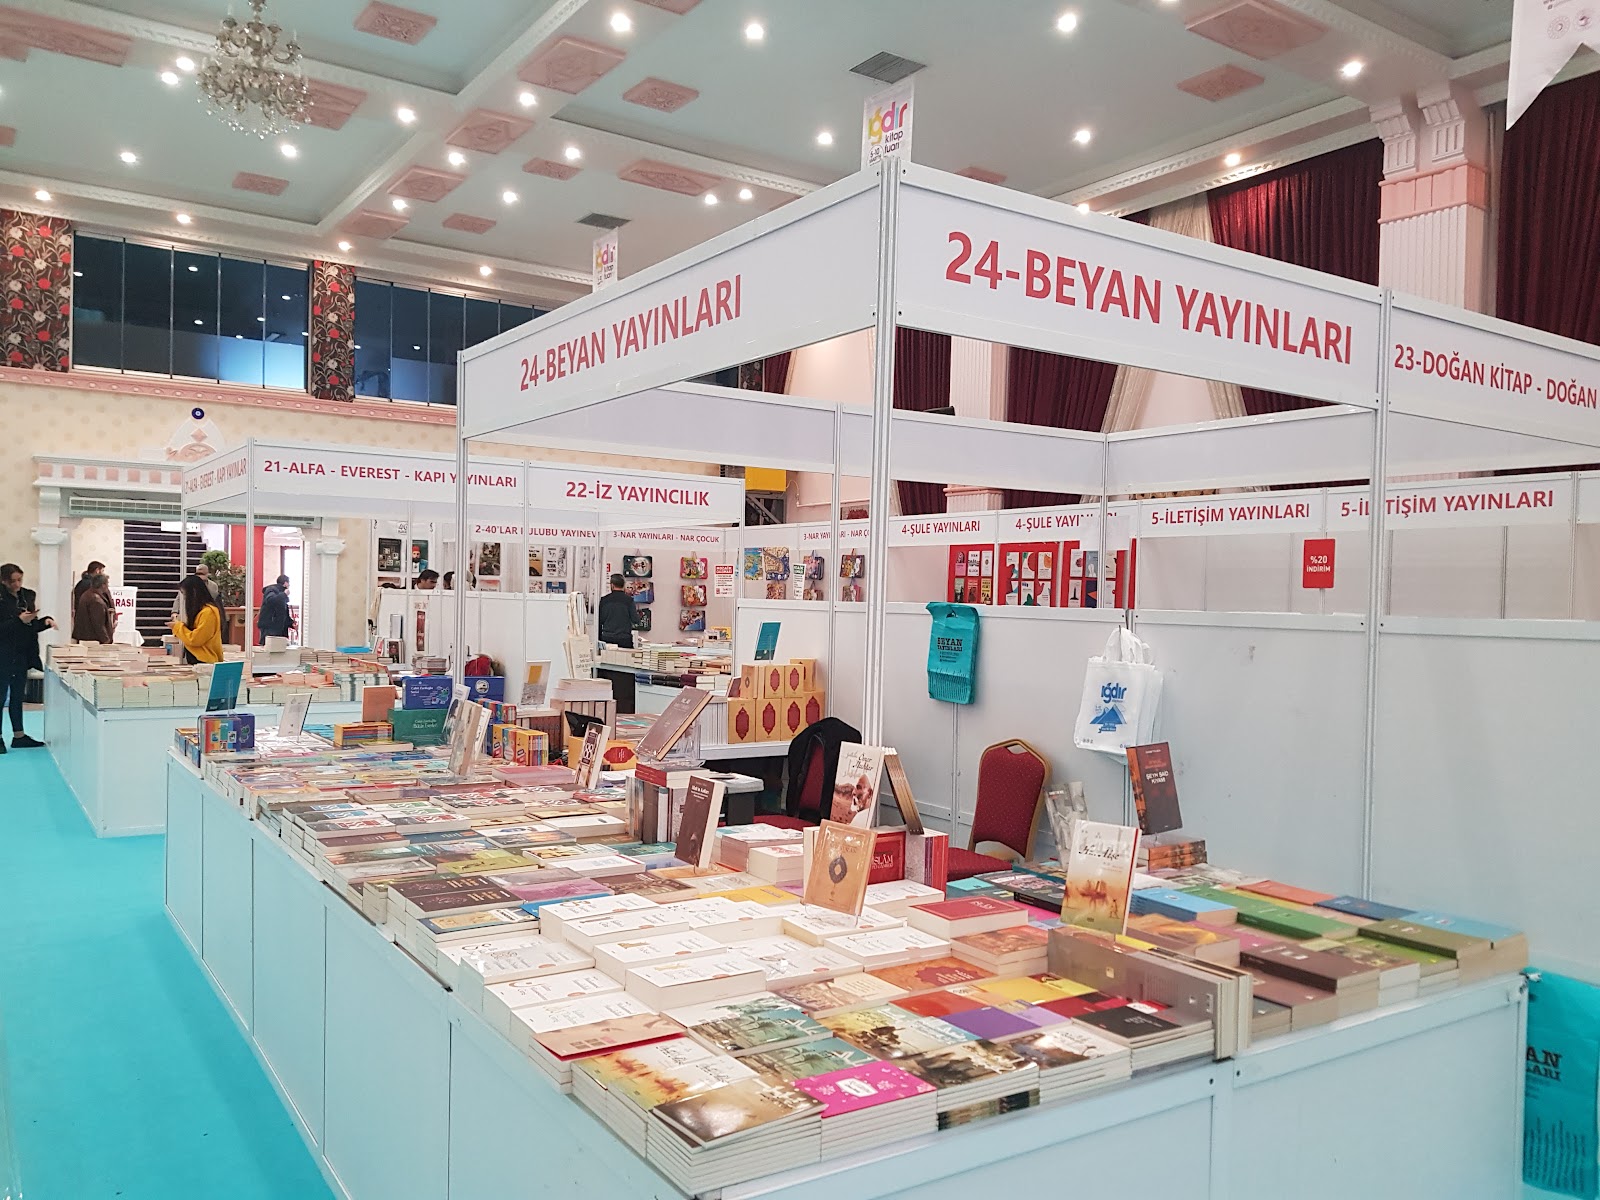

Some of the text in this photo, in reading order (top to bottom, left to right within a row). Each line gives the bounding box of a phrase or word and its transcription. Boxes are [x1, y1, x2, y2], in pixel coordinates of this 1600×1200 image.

[945, 231, 1352, 365] 24-BEYAN YAYINLARI
[520, 274, 741, 392] 24-BEYAN YAYINLARI
[1394, 343, 1485, 385] 23-DOĞAN
[1489, 362, 1533, 394] KİTAP
[1546, 377, 1597, 409] DOĞAN
[263, 459, 326, 476] 21-ALFA
[340, 464, 401, 480] EVEREST
[414, 471, 446, 484] KAPI
[449, 472, 517, 488] YYINLARI
[565, 480, 710, 507] 22-İZ YAYINCILIK
[1340, 489, 1554, 519] 5-İLTİŞİM YAYINLARI
[1151, 503, 1310, 526] 5-İLETİŞİM YAYINLARI
[475, 524, 519, 535] 2-40'LAR
[560, 528, 597, 538] YAYINEV
[900, 519, 981, 536] 4-ŞULE YAYINLARI
[1015, 515, 1052, 533] 4-ŞULE
[613, 530, 637, 539] 3-NAR
[638, 532, 674, 541] YAYINLARI
[680, 534, 695, 542] NAR
[696, 535, 720, 544] ÇOCUK
[803, 532, 819, 541] 3-NAR
[820, 530, 846, 540] YAYIRI
[850, 529, 863, 538] NAR
[1310, 555, 1328, 564] %20
[1306, 565, 1331, 573] İNDİRİM
[112, 598, 134, 607] RASI
